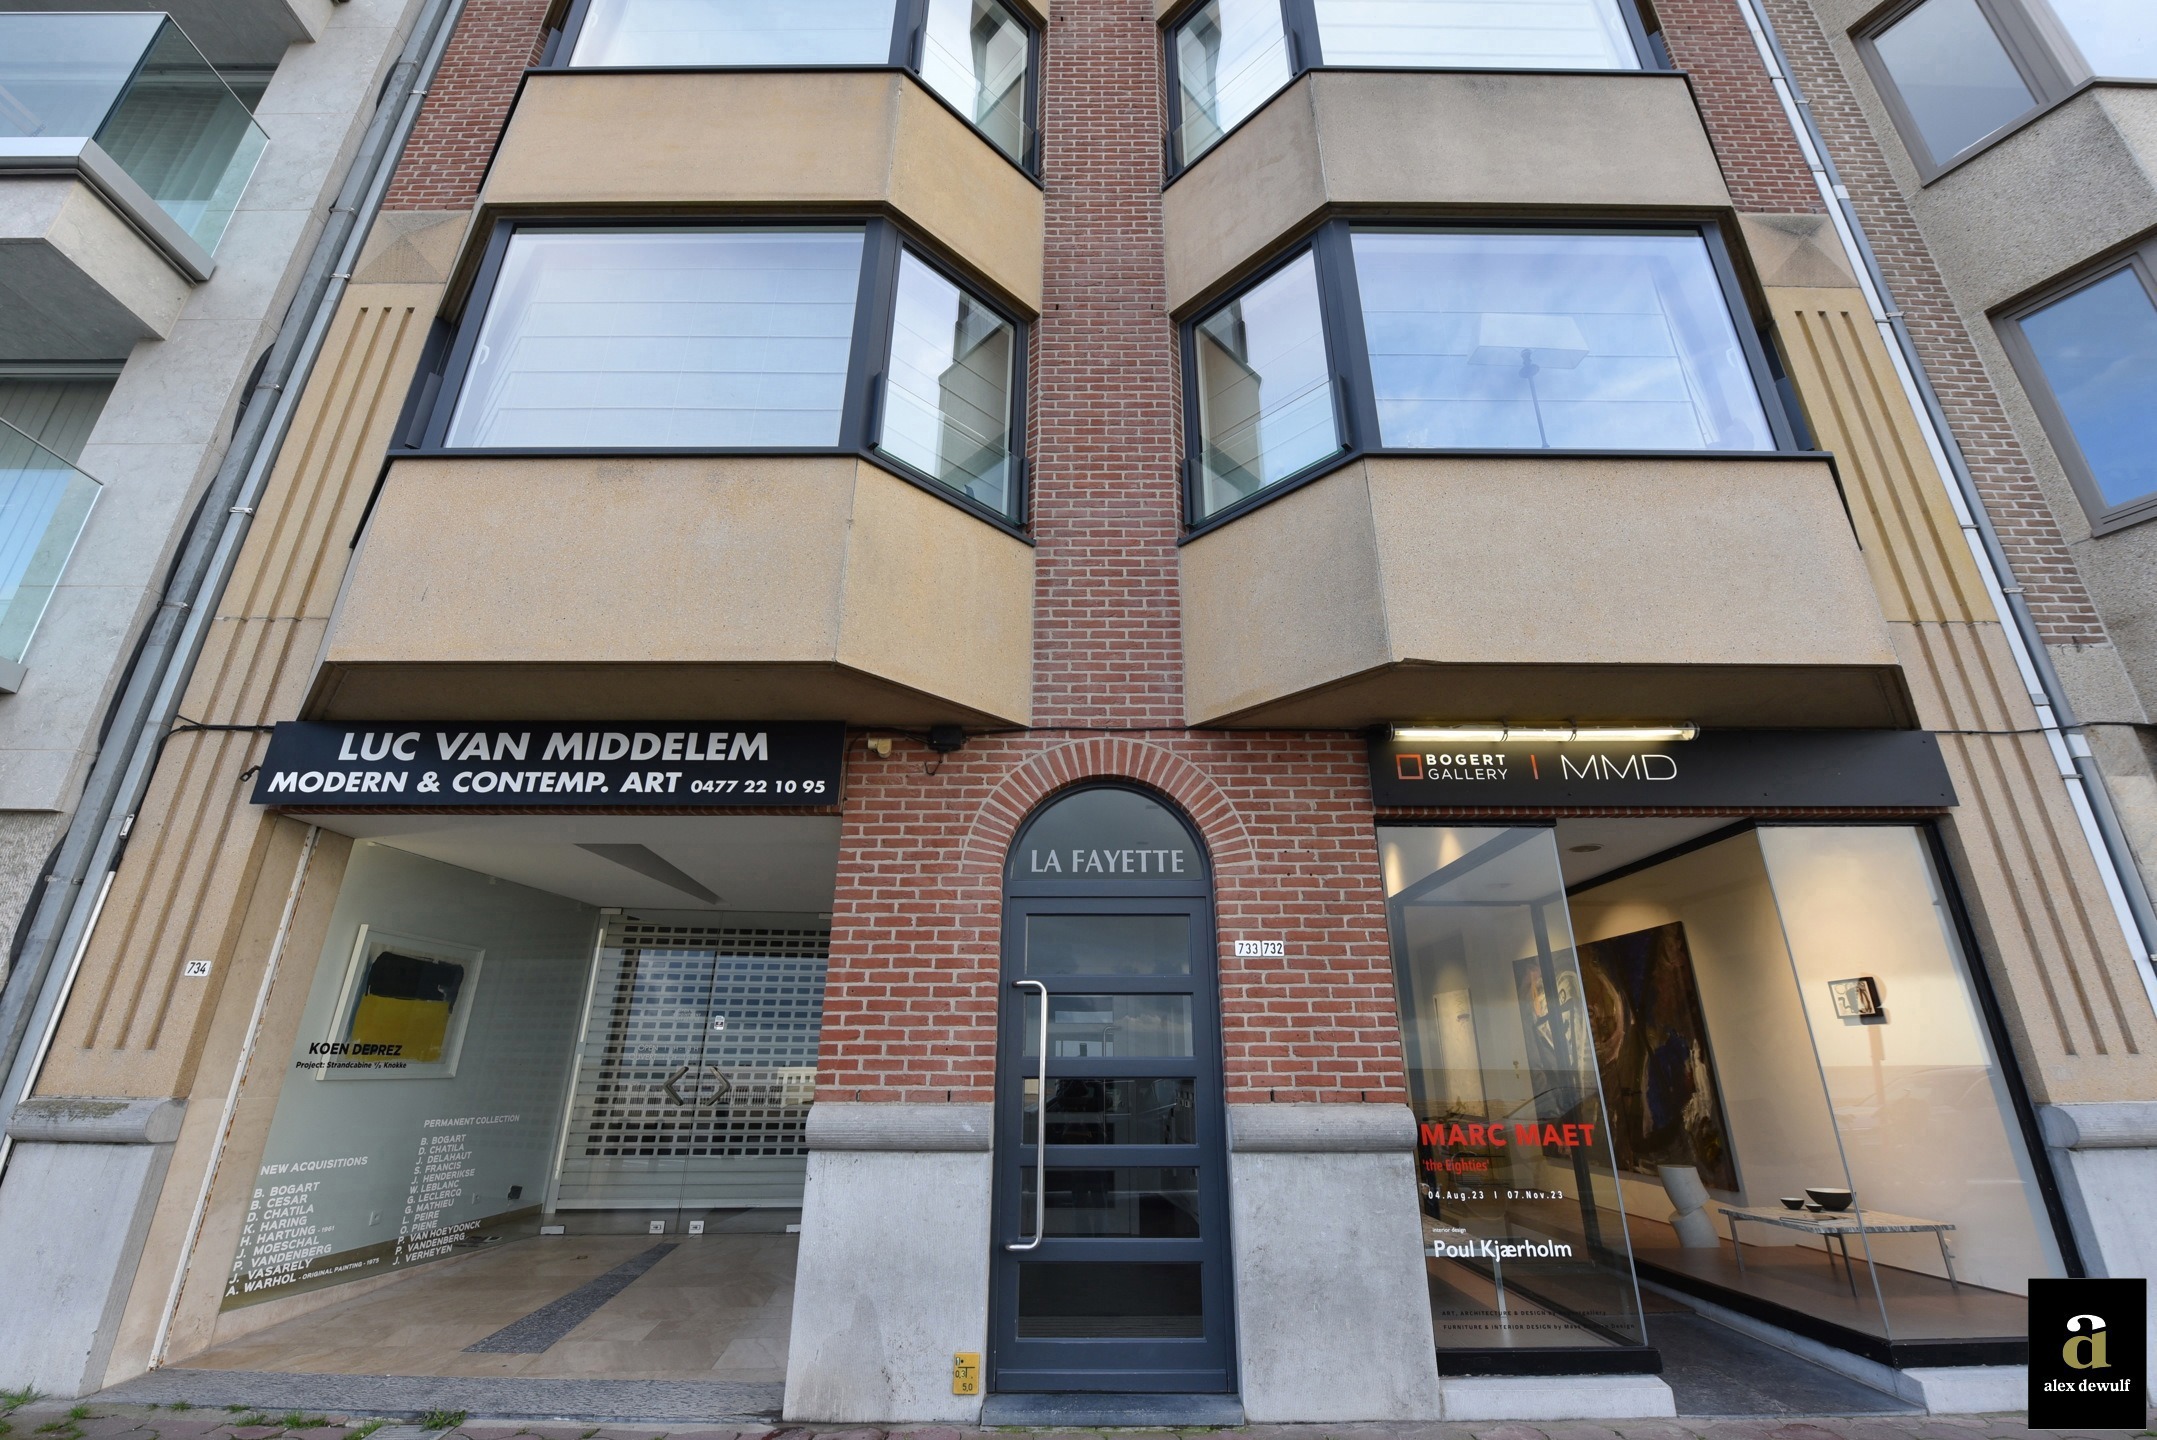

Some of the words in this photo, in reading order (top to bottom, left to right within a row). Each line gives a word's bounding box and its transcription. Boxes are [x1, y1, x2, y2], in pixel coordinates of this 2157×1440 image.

[338, 732, 420, 761] LUC
[436, 732, 535, 761] VAN
[542, 732, 769, 761] MIDDELEM
[1425, 754, 1506, 766] BOGERT
[1560, 754, 1678, 780] MMD
[1428, 768, 1508, 780] GALLERY
[267, 771, 409, 793] MODERN
[416, 771, 440, 793] &
[452, 771, 610, 793] CONTEMP.
[620, 771, 683, 793] ART
[690, 780, 738, 794] 0477
[743, 780, 768, 794] 22
[774, 780, 797, 794] 10
[802, 780, 826, 794] 95
[1031, 850, 1062, 873] LA
[1071, 850, 1185, 873] FAYETTE
[1238, 943, 1258, 955] 733
[1263, 943, 1283, 955] 732
[187, 962, 207, 974] 734
[308, 1042, 349, 1055] KOEN
[351, 1043, 403, 1056] DEPREZ
[423, 1117, 475, 1128] PERMANENT
[475, 1114, 520, 1125] COLLECTION
[420, 1137, 428, 1146] B.
[432, 1134, 466, 1145] BOGART
[1421, 1123, 1507, 1147] MARC
[1515, 1123, 1595, 1147] MAET
[416, 1156, 422, 1164] J.
[427, 1151, 472, 1164] DELAHAUT
[418, 1147, 426, 1155] D.
[430, 1144, 464, 1154] CHATILA
[260, 1163, 289, 1176] NEW
[290, 1156, 368, 1173] ACQUISITIONS
[414, 1166, 422, 1174] S.
[424, 1162, 462, 1173] FRANCIS
[411, 1176, 418, 1184] J.
[422, 1168, 476, 1183] HENDERIKSE
[254, 1188, 265, 1198] B.
[270, 1182, 320, 1197] BOGART
[410, 1186, 418, 1194] W.
[420, 1180, 460, 1193] LEBLANC
[250, 1200, 261, 1210] B.
[266, 1194, 308, 1208] CESAR
[407, 1196, 416, 1204] G.
[418, 1188, 462, 1202] LECLERCQ
[1428, 1191, 1484, 1201] 04.Aug.23
[1507, 1191, 1563, 1199] 07.Nov.23
[247, 1212, 258, 1222] D.
[264, 1204, 314, 1220] CHATILA
[404, 1206, 413, 1214] G.
[416, 1198, 455, 1212] MATHIEU
[243, 1224, 255, 1234] K.
[260, 1216, 307, 1232] HARING
[402, 1216, 410, 1224] L.
[414, 1210, 440, 1222] PEIRE
[397, 1236, 405, 1245] P.
[410, 1232, 428, 1242] VAN
[430, 1220, 482, 1238] HOEYDONCK
[400, 1226, 408, 1234] O.
[412, 1220, 438, 1232] PIENE
[240, 1236, 252, 1247] H.
[256, 1225, 316, 1244] HARTUNG
[395, 1246, 402, 1255] P.
[408, 1233, 465, 1252] VANDENBERG
[236, 1249, 246, 1259] J.
[253, 1236, 320, 1256] MOESCHAL
[405, 1244, 453, 1262] VERHEYEN
[1434, 1240, 1475, 1258] Poul
[1481, 1240, 1572, 1262] Kjærholm
[233, 1261, 243, 1271] P.
[251, 1244, 332, 1268] VANDENBERG
[229, 1273, 239, 1284] J.
[248, 1258, 314, 1280] VASARELY
[225, 1286, 239, 1297] A.
[244, 1273, 297, 1293] WARHOL
[302, 1268, 333, 1280] ORIGINAL
[334, 1262, 362, 1273] PAINTING
